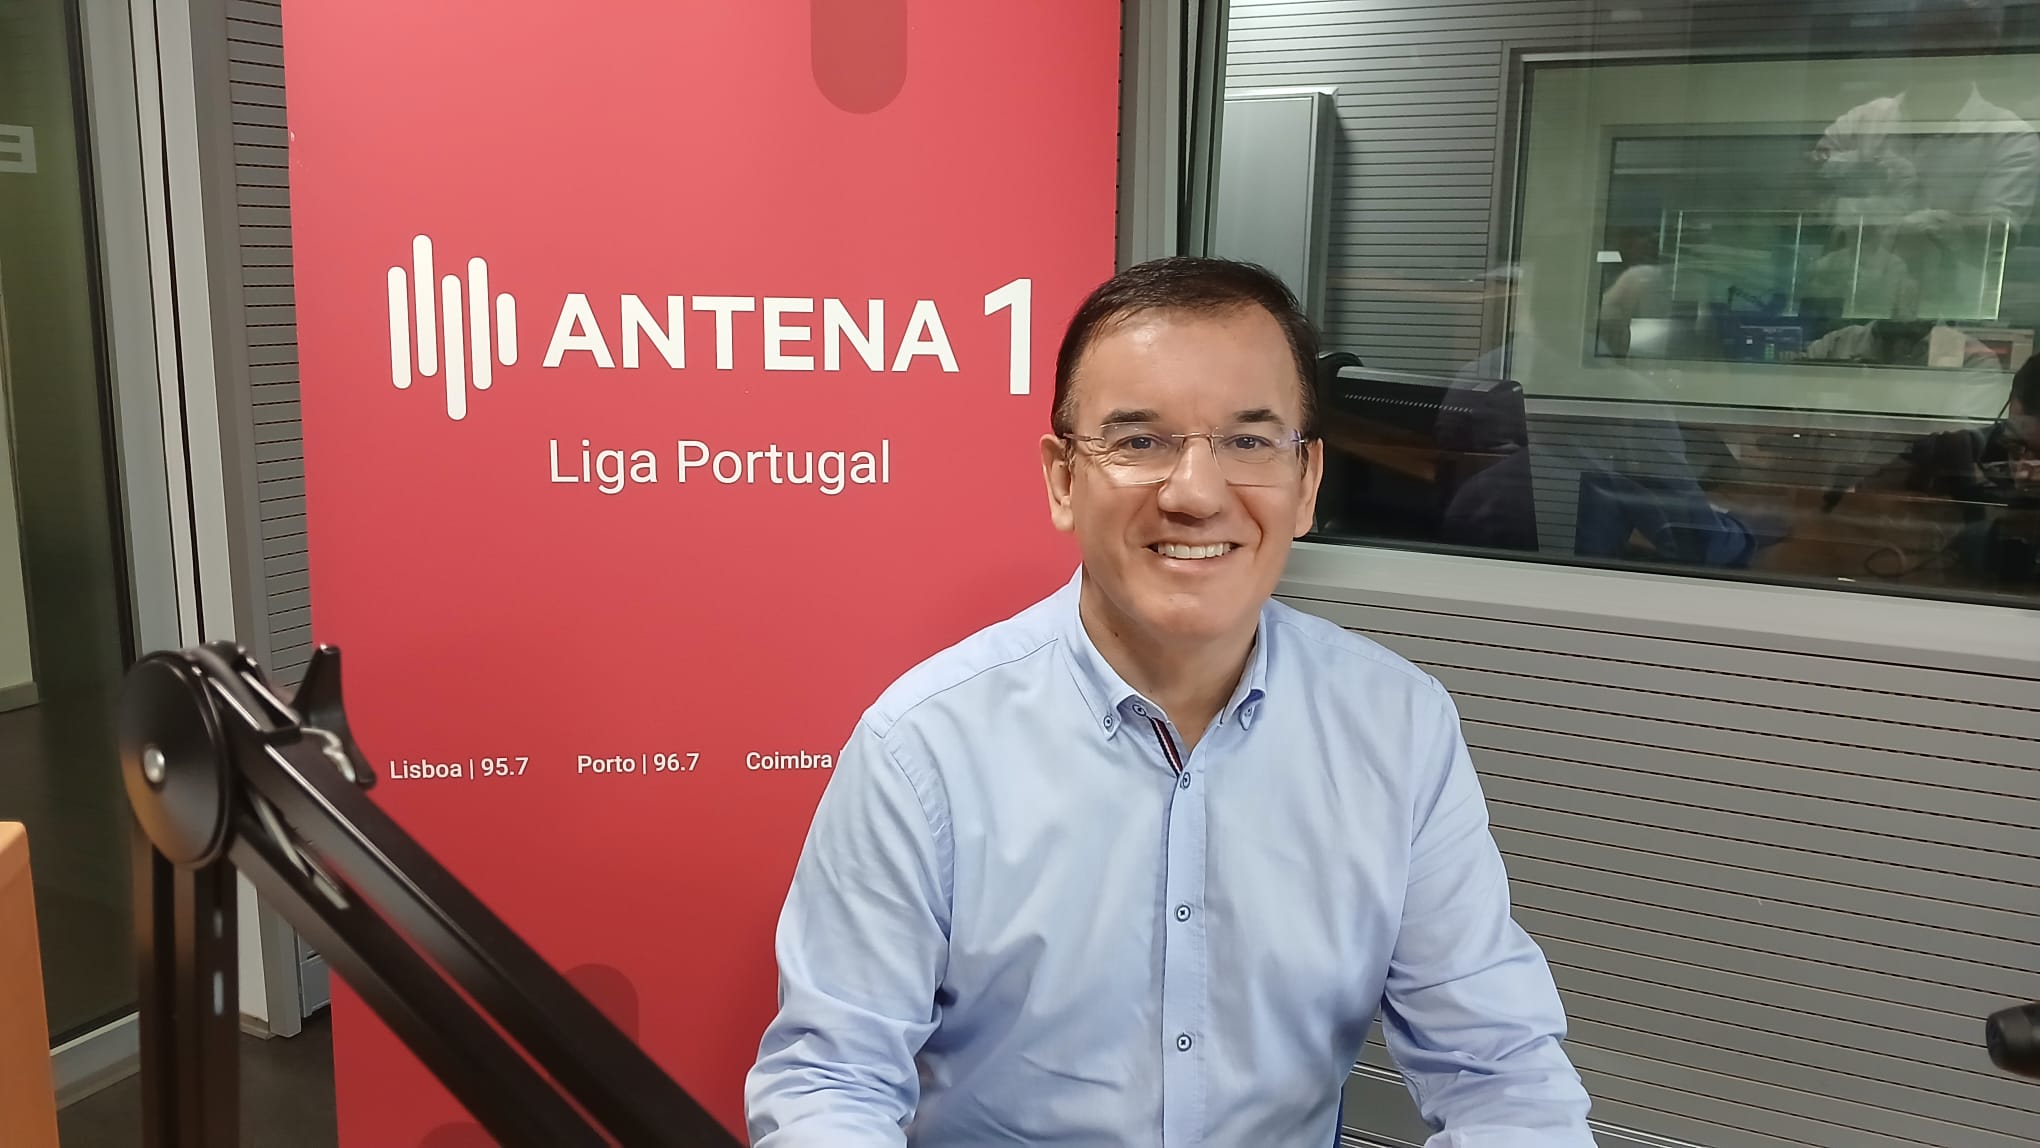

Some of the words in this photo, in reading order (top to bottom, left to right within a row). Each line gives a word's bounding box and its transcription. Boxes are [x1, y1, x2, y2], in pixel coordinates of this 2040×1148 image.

[542, 293, 960, 373] ANTENA
[984, 278, 1032, 395] 1
[549, 439, 658, 495] Liga
[677, 439, 890, 495] Portugal
[390, 759, 463, 779] Lisboa
[481, 756, 529, 777] 95.7
[577, 755, 636, 774] Porto
[653, 752, 700, 773] 96.7
[746, 750, 833, 770] Coimbra
